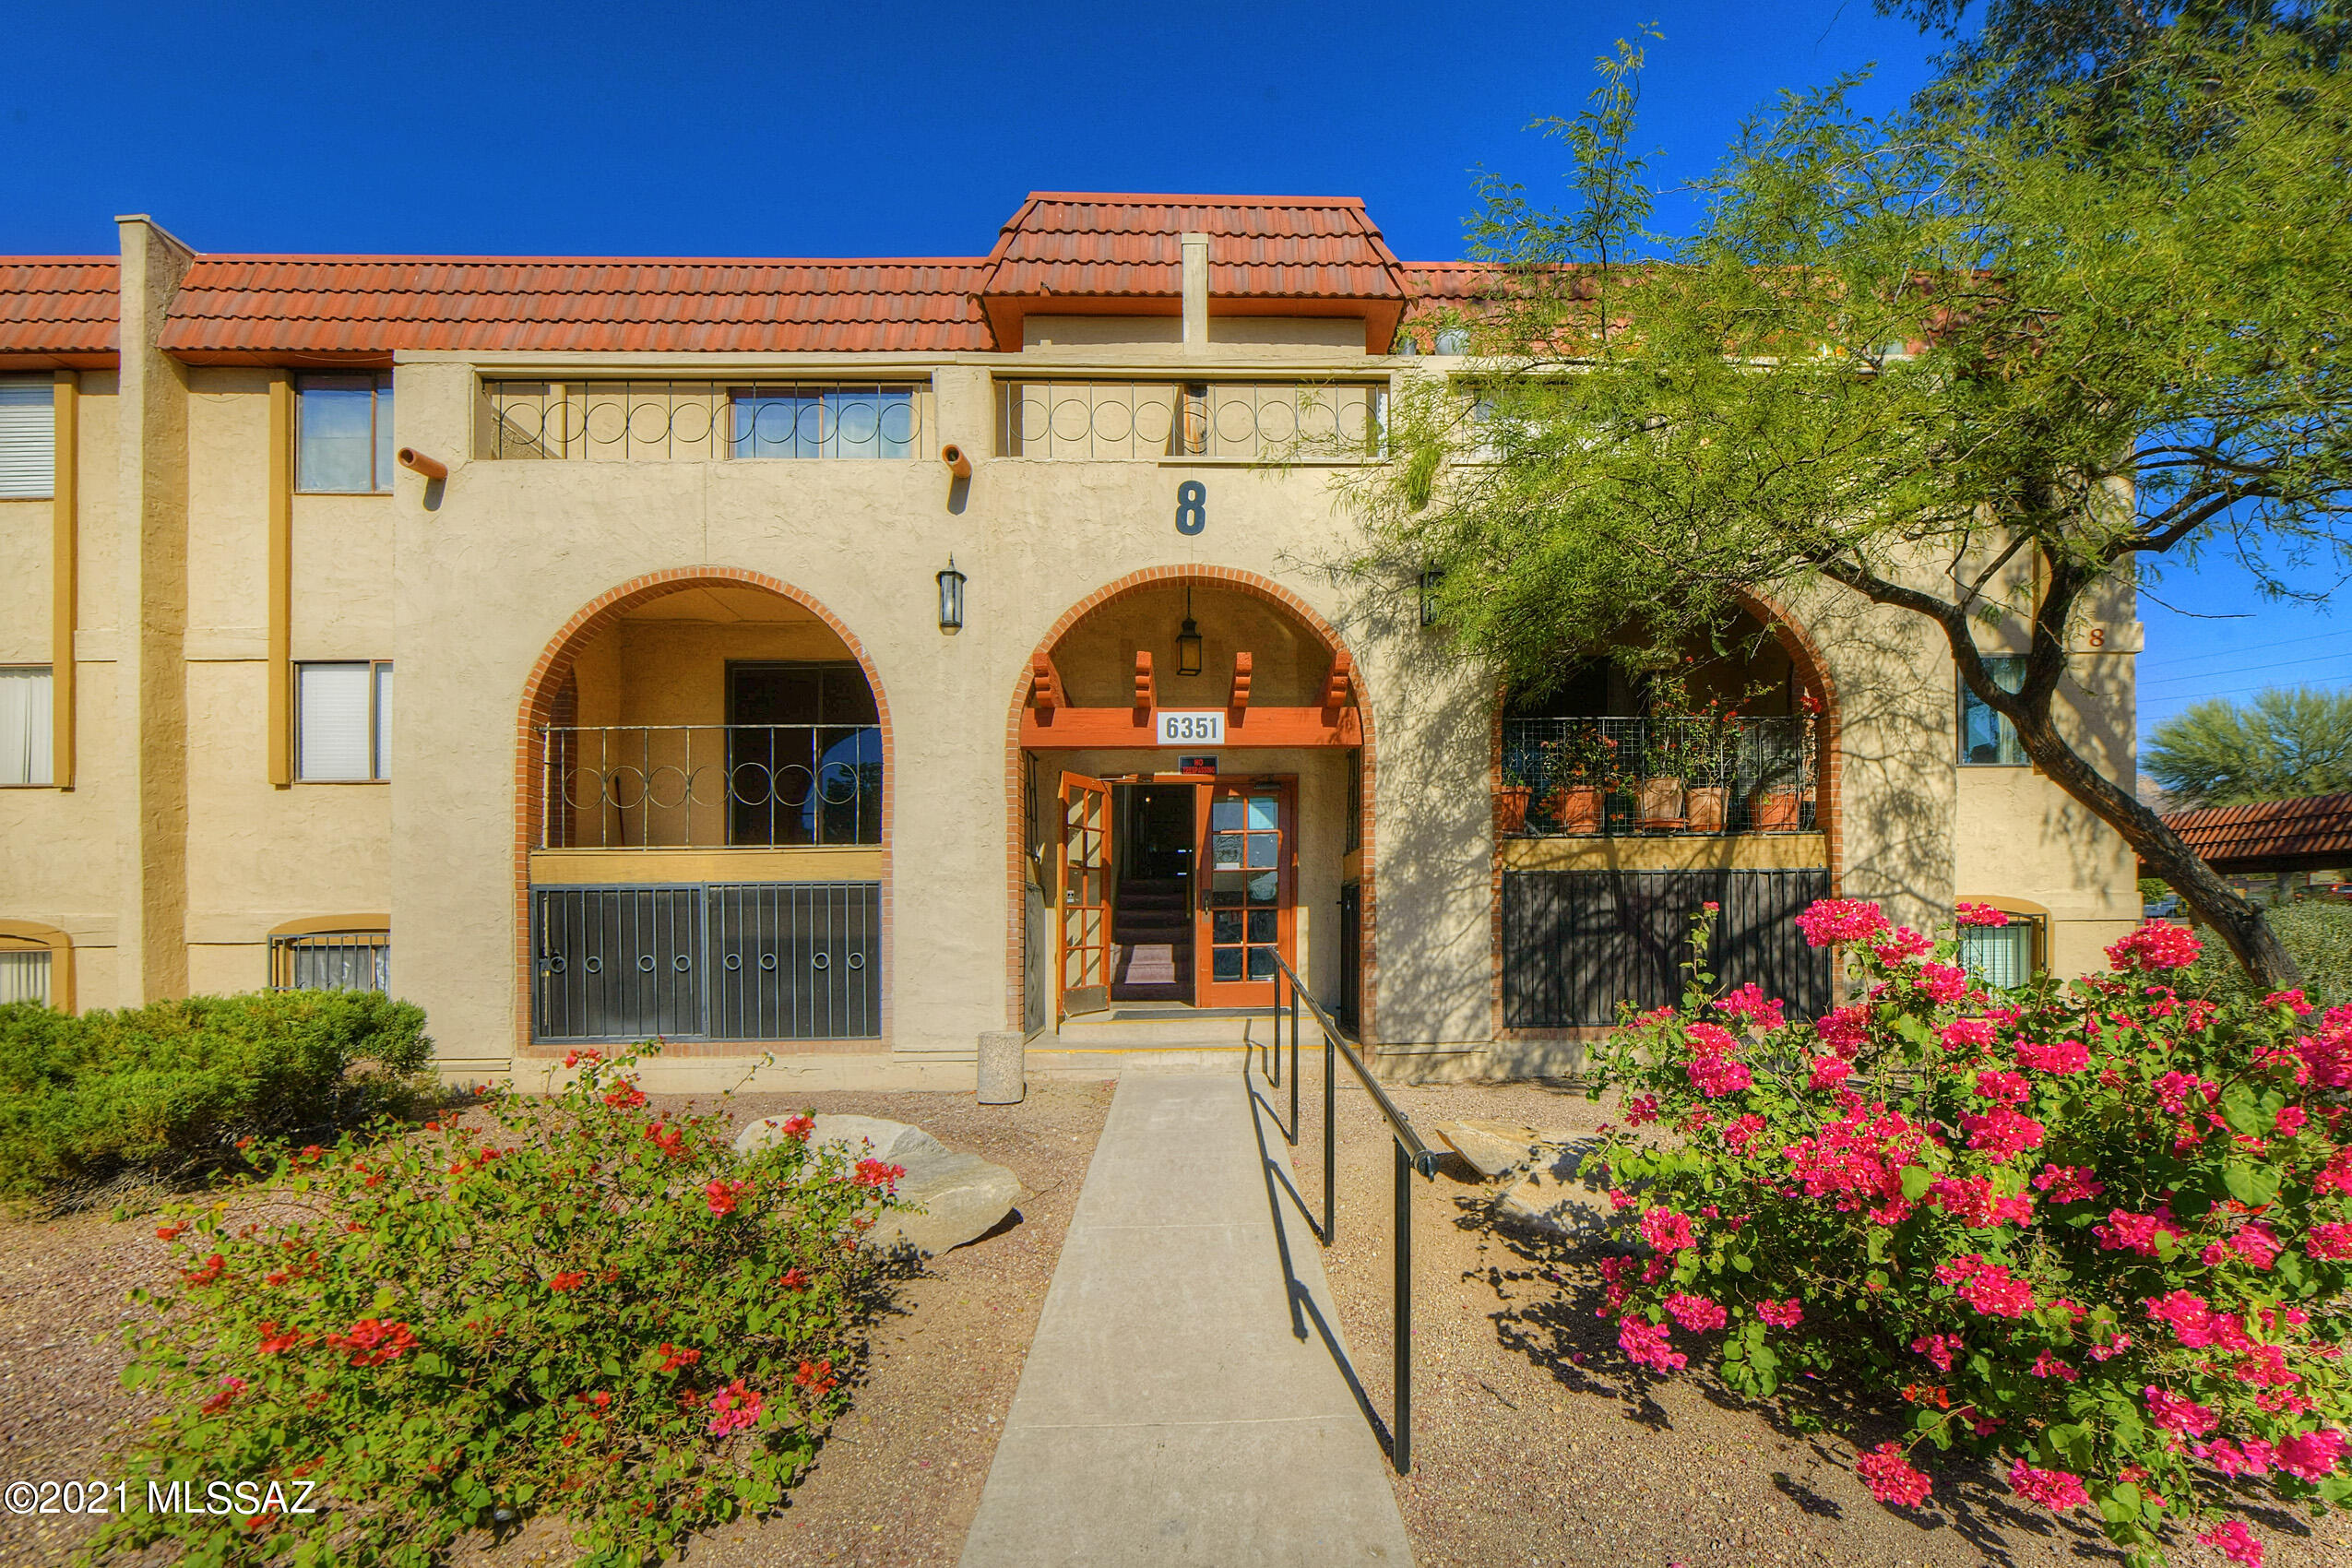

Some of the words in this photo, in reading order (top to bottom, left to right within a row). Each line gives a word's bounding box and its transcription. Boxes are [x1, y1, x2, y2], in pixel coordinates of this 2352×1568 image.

[1175, 480, 1206, 536] 8
[2089, 628, 2104, 647] 8
[1166, 717, 1217, 739] 6351
[1182, 766, 1216, 775] TRESPASSING
